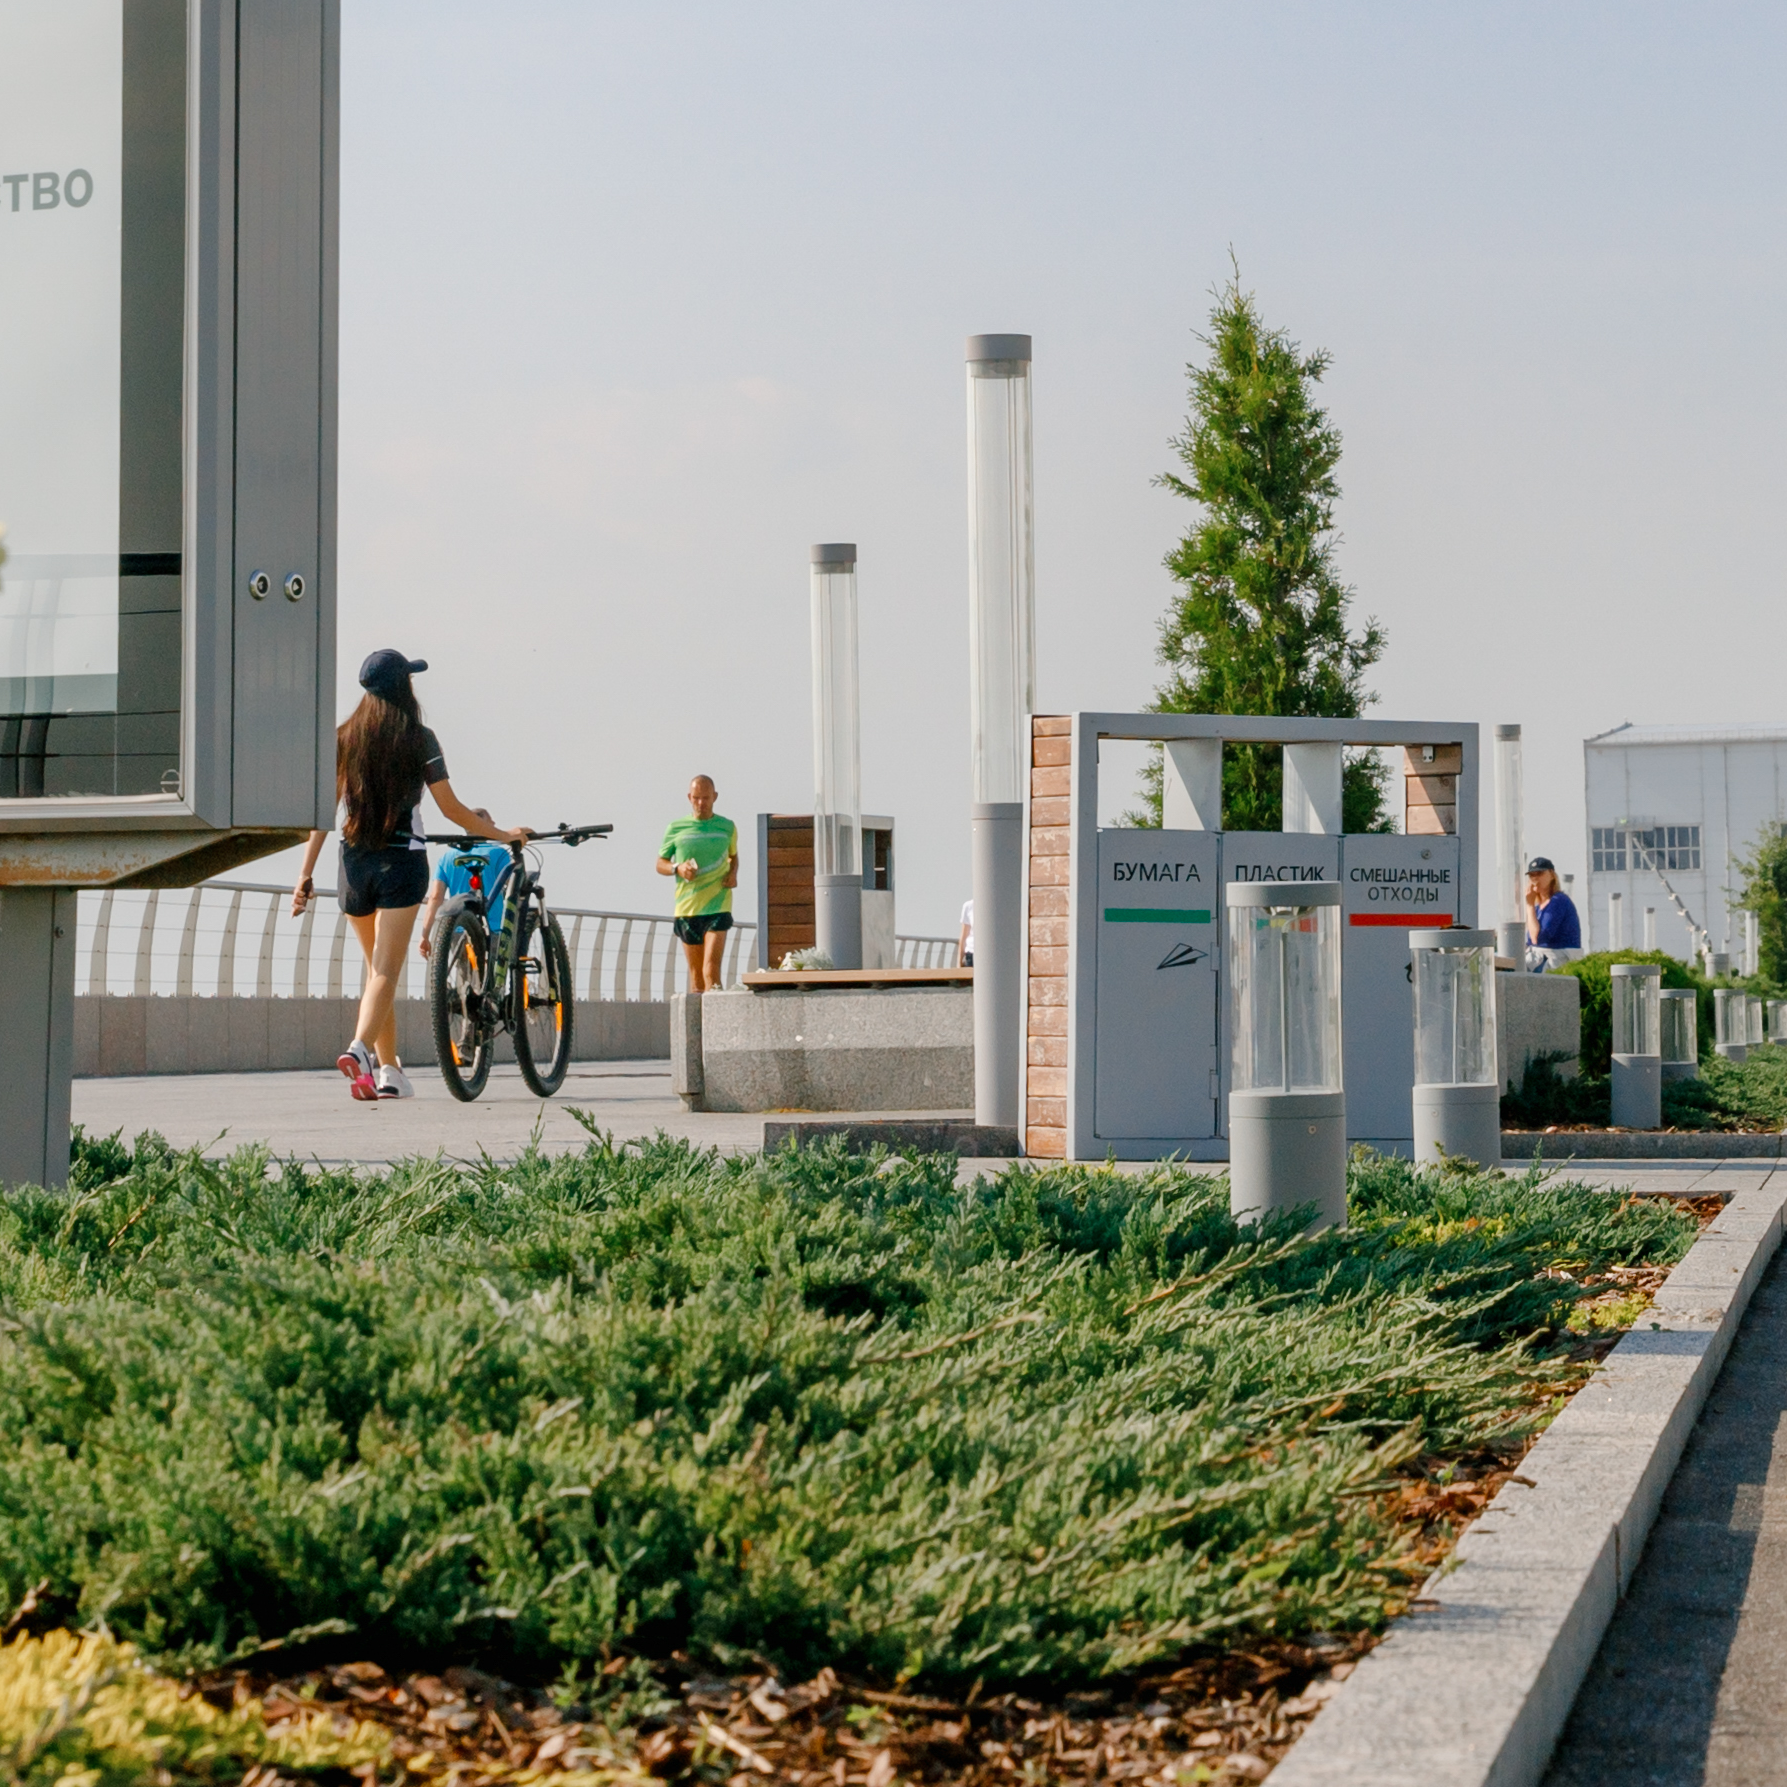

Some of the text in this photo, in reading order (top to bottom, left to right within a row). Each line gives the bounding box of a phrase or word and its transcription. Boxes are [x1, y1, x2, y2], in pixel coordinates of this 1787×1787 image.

[1113, 862, 1201, 883] БУМАГА
[1234, 865, 1326, 882] ПЛАСТИК
[1350, 867, 1451, 884] СМЕШАННЫЕ
[1367, 886, 1440, 904] ОТХОДЫ
